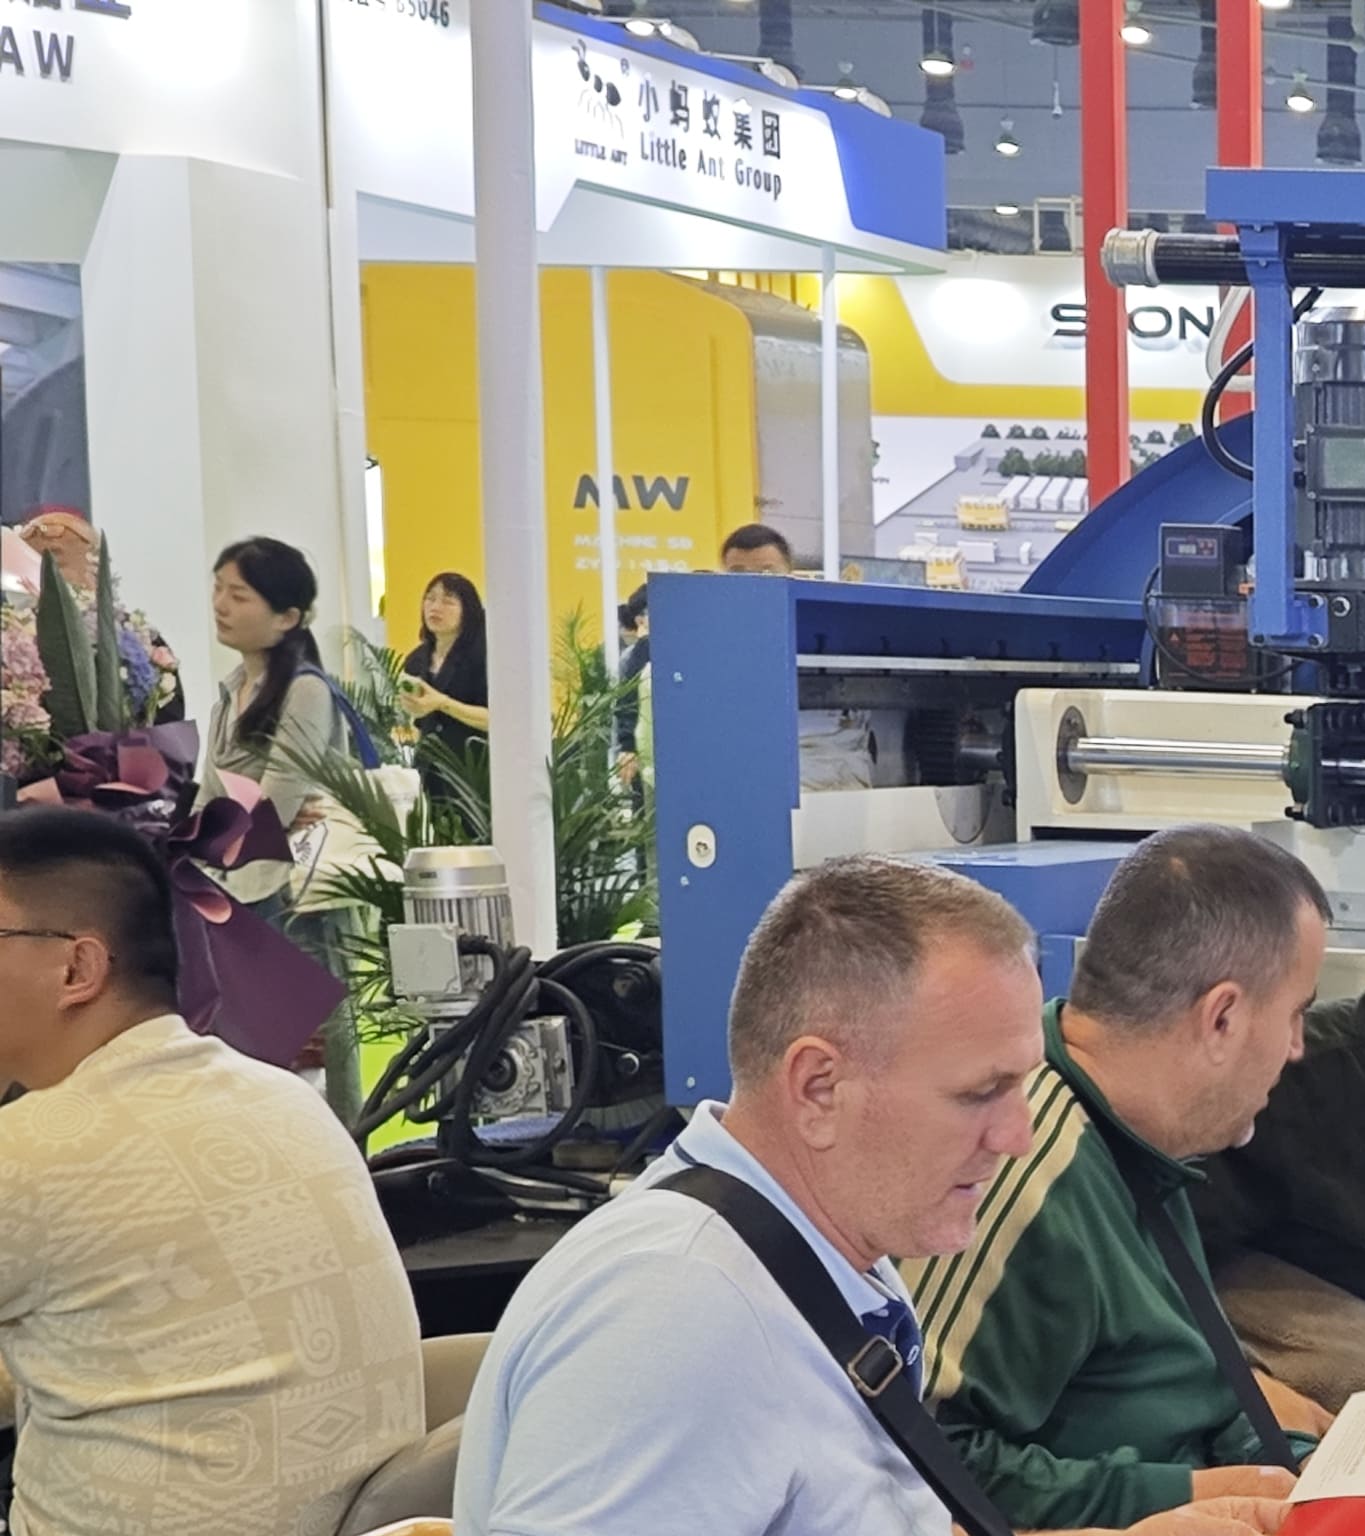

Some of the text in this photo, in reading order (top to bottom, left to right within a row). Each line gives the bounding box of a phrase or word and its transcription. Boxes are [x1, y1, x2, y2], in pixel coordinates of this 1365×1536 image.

[640, 131, 782, 202] Little Ant Group
[1051, 303, 1214, 340] SON
